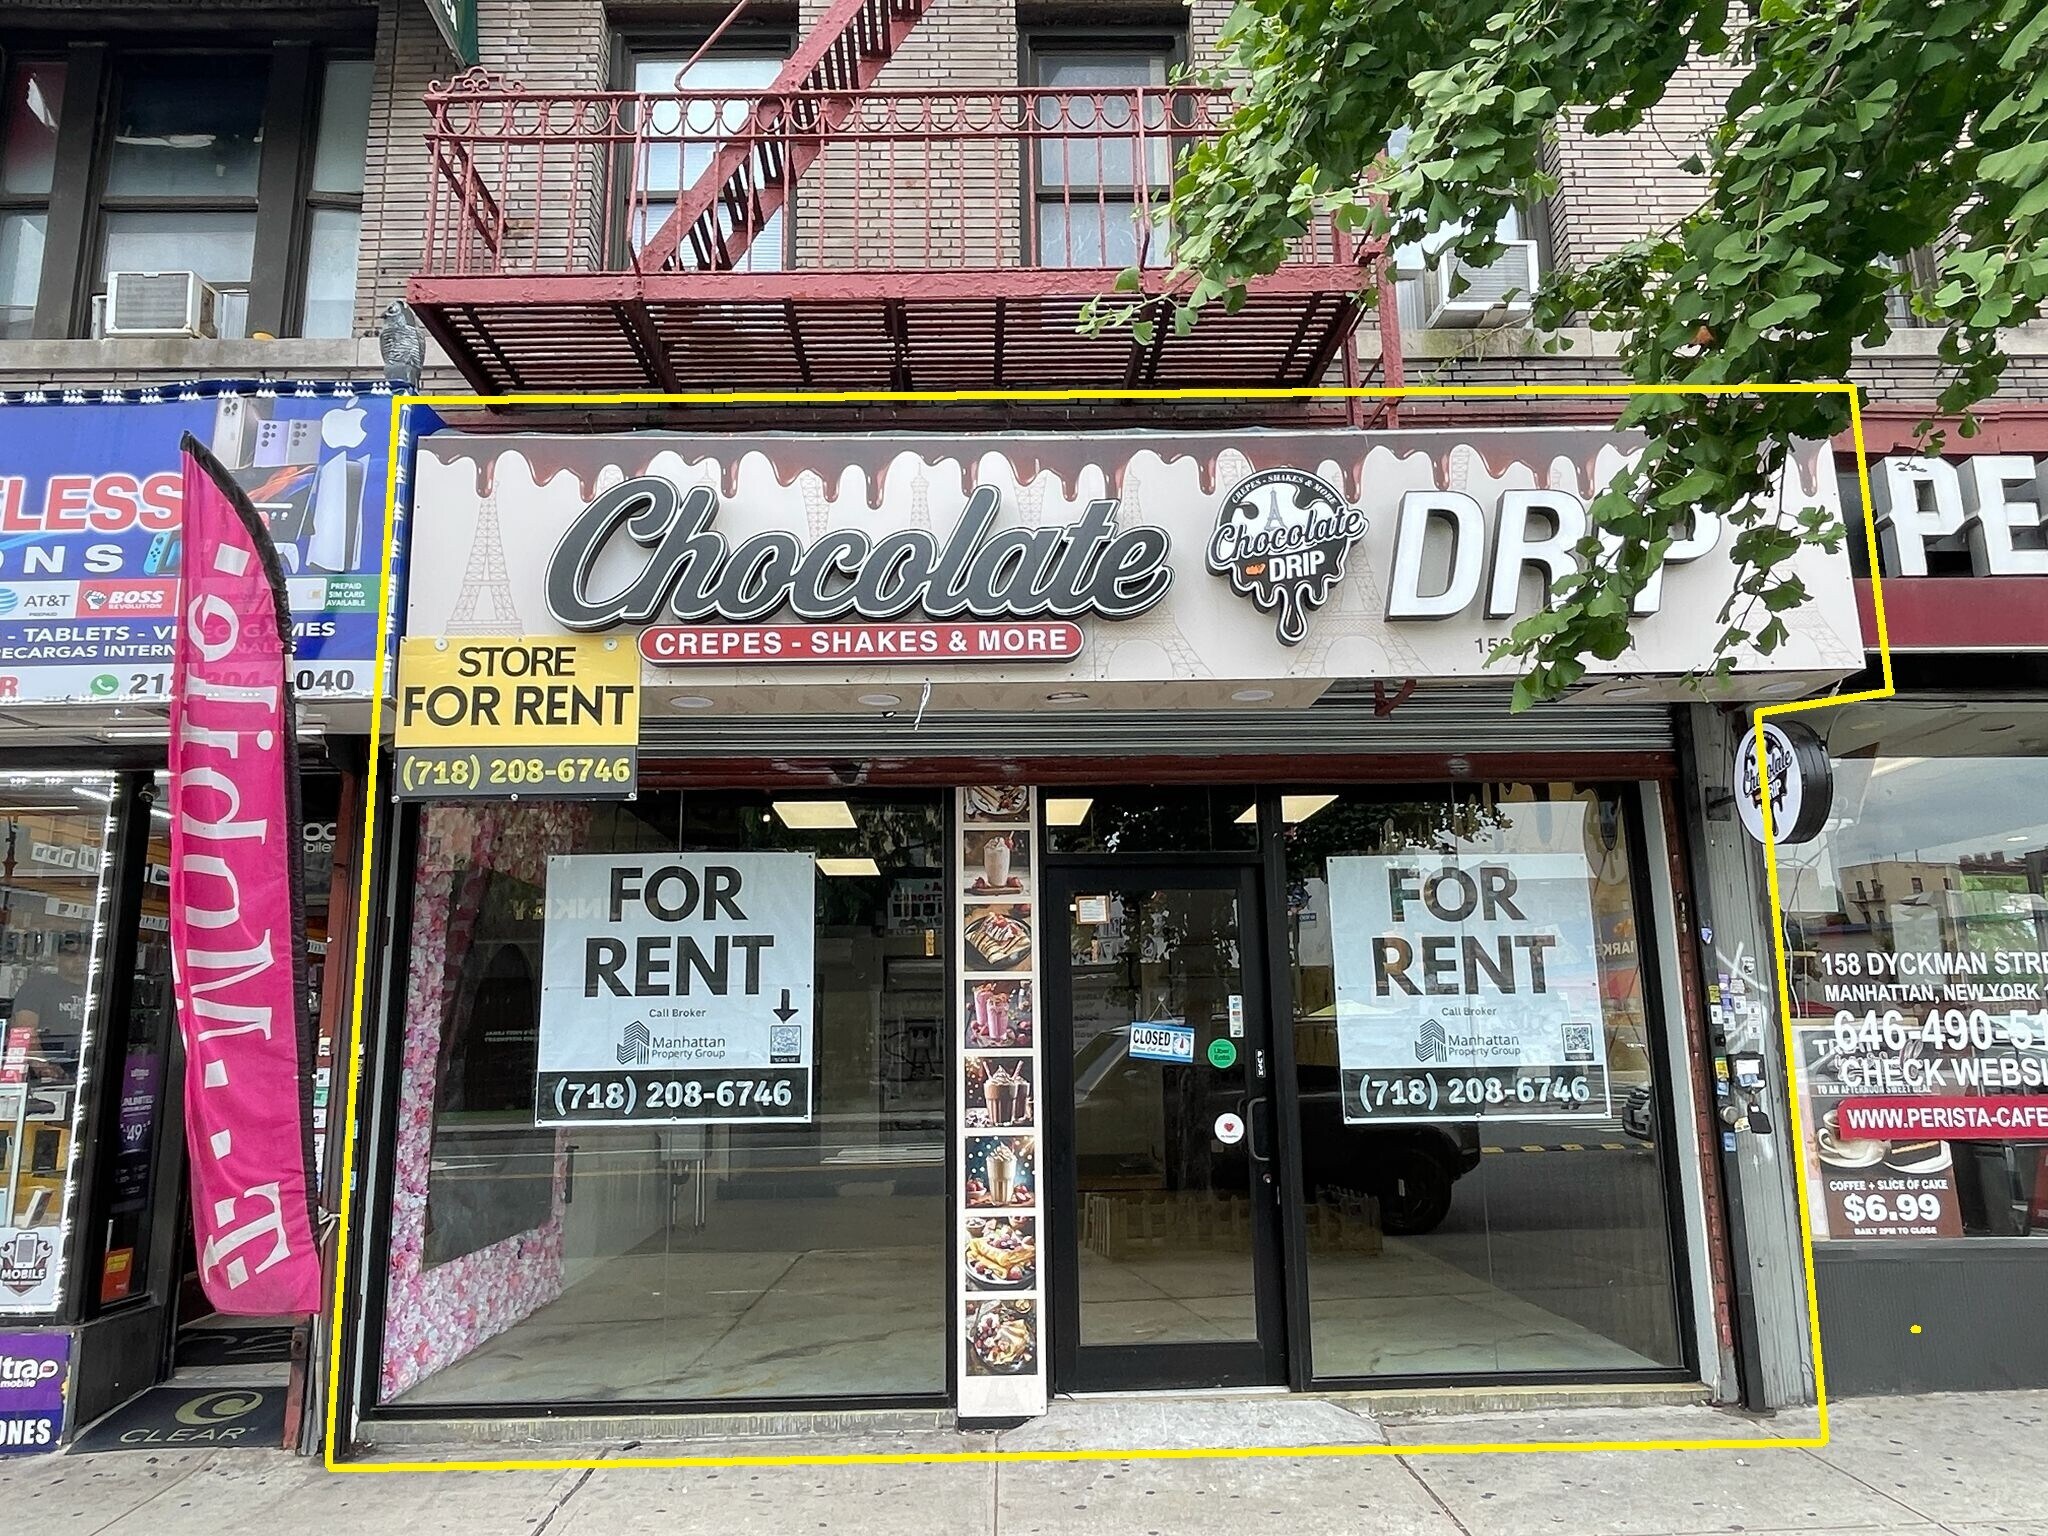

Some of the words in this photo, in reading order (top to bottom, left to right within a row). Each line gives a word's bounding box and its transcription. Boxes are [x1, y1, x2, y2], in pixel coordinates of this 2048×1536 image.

[1209, 506, 1369, 564] Chocolate
[544, 475, 1175, 631] Chocolate
[1269, 551, 1326, 583] DRIP
[331, 582, 361, 590] PREPAID
[24, 594, 70, 608] AT&T
[108, 590, 165, 604] BOSS
[326, 599, 366, 607] AVAILABLE
[23, 626, 130, 643] TABLETS
[655, 632, 782, 655] CREPES
[811, 630, 938, 653] SHAKES
[948, 629, 968, 651] &
[979, 629, 1067, 651] MORE
[457, 646, 576, 677] STORE
[403, 686, 501, 727] FOR
[514, 685, 634, 726] RENT
[402, 754, 480, 791] (718)
[490, 757, 631, 784] 208-6746
[609, 866, 748, 923] FOR
[1388, 867, 1527, 923] FOR
[584, 935, 774, 998] RENT
[1372, 935, 1556, 996] RENT
[1821, 952, 1861, 976] 158
[1867, 952, 1988, 976] DYCKMAN
[1825, 984, 1940, 1004] MANHATTAN,
[1943, 984, 1985, 1001] NEW
[1986, 984, 2041, 1001] YORK
[649, 1009, 669, 1018] Call
[672, 1008, 706, 1018] Broker
[1441, 1007, 1461, 1016] Call
[1463, 1007, 1497, 1016] Broker
[652, 1036, 726, 1048] Manhattan
[1133, 1029, 1171, 1047] CLOSED
[1448, 1034, 1520, 1046] Manhattan
[652, 1050, 692, 1060] Property
[695, 1049, 726, 1060] Group
[1448, 1048, 1489, 1057] Property
[1491, 1046, 1521, 1057] Group
[1842, 1058, 1947, 1087] CHECK
[554, 1075, 637, 1116] (718)
[646, 1079, 792, 1109] 208-6746
[1360, 1073, 1439, 1112] (718)
[1448, 1076, 1590, 1104] 208-6746
[1829, 1180, 1867, 1191] COFFEE
[1877, 1180, 1906, 1191] SLICE
[1906, 1180, 1920, 1190] OF
[1921, 1179, 1948, 1190] CAKE
[1843, 1193, 1941, 1225] $6.99
[1854, 1227, 1878, 1235] DAILY
[1898, 1227, 1909, 1235] TO
[1, 1268, 46, 1280] MOBILE
[120, 1427, 246, 1443] CLEAR
